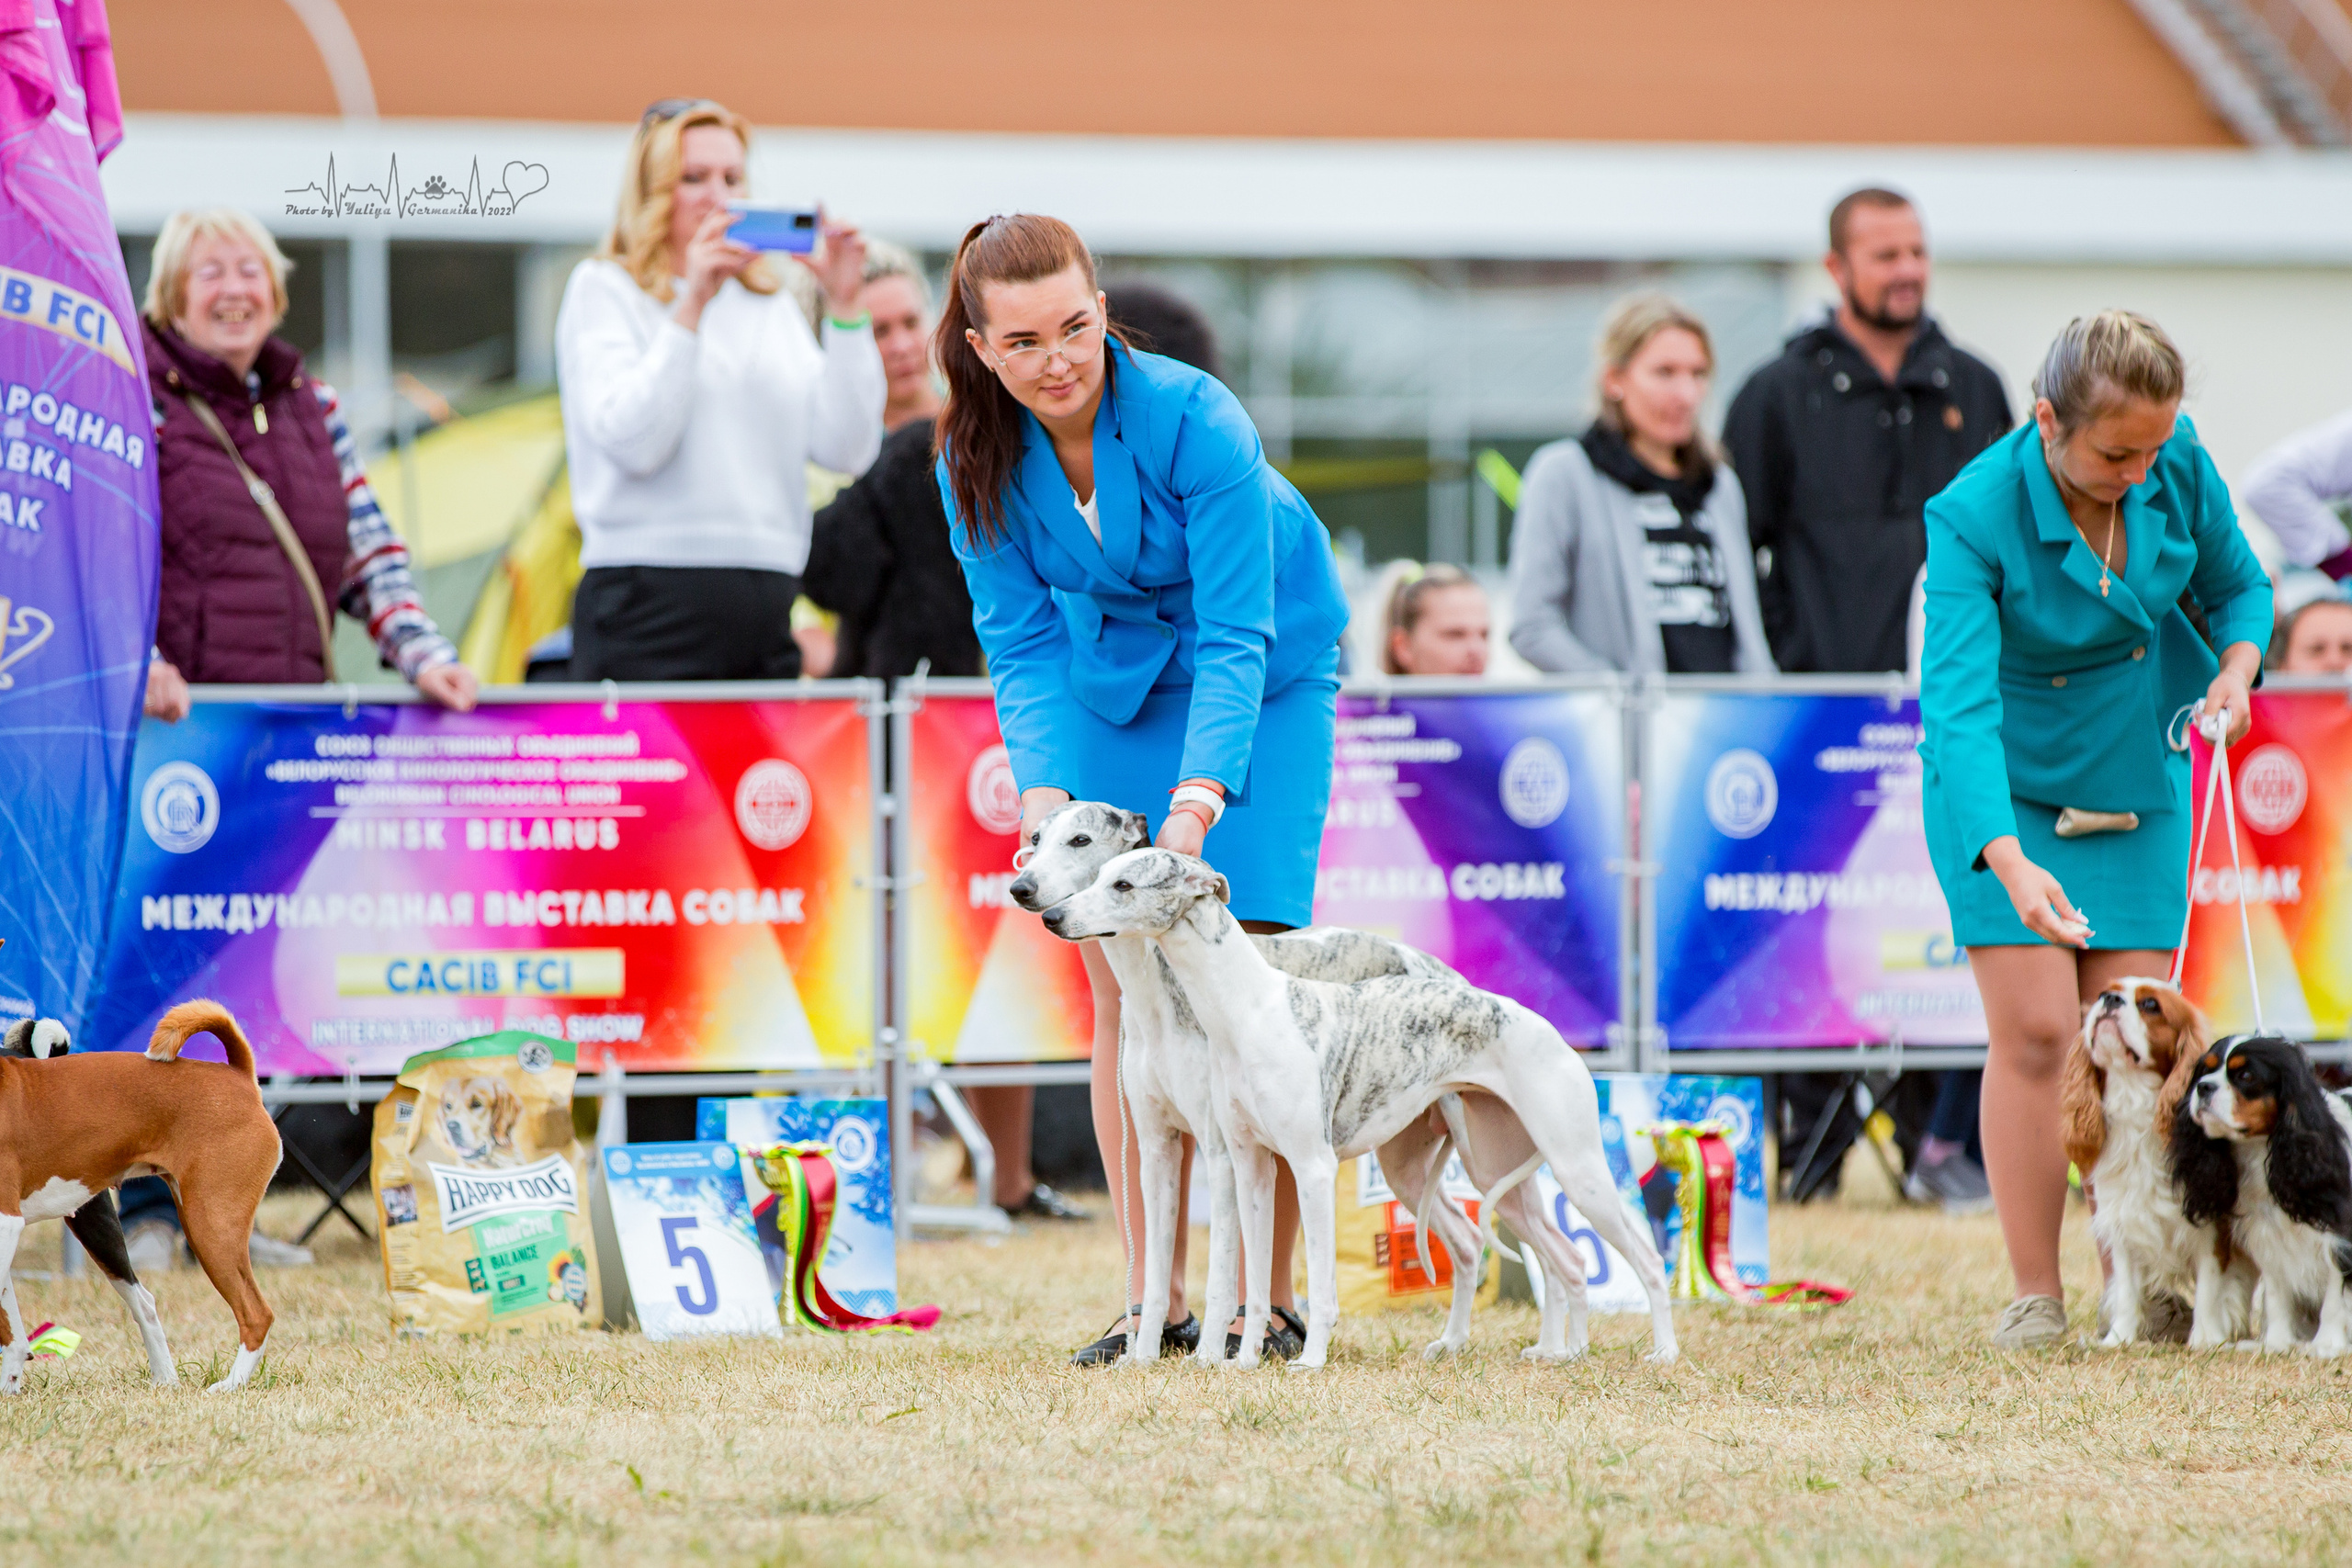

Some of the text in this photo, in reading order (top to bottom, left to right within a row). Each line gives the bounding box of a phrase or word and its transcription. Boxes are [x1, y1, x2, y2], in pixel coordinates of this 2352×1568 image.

[48, 292, 106, 345] FCI
[0, 438, 73, 493] ВКА
[335, 817, 620, 852] MINSK BELARUS
[1450, 862, 1566, 902] СОБАК
[2194, 864, 2302, 906] СОБАК
[141, 887, 806, 935] МЕЖДУНАРОДНАЯ ВЫСТАВКА СОБАК
[386, 958, 575, 994] CACIB FCI
[566, 1013, 644, 1043] SHOW
[443, 1168, 572, 1213] HAPPY DOG
[1555, 1191, 1609, 1286] 6
[660, 1216, 718, 1316] 5
